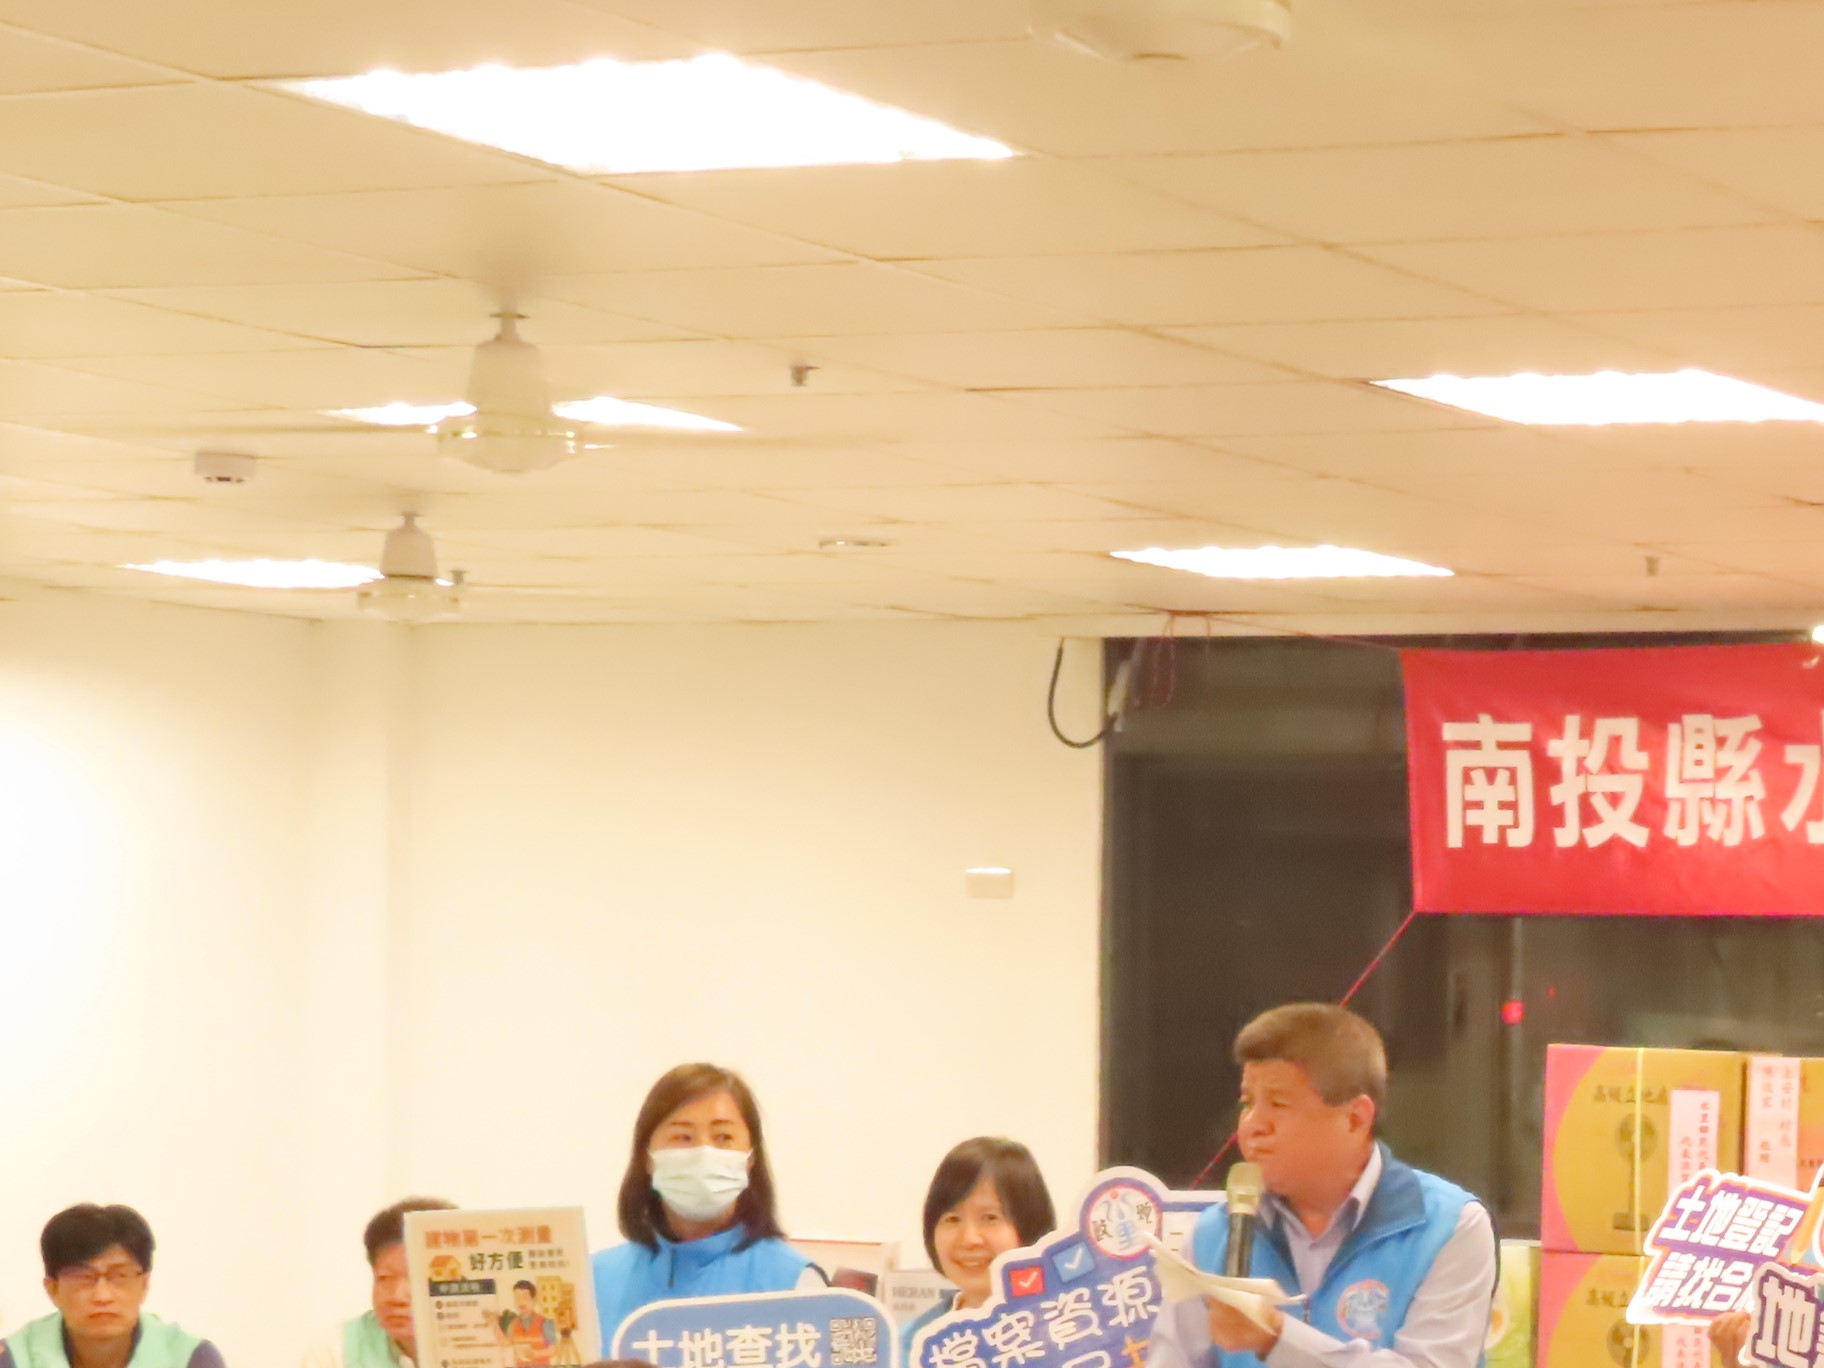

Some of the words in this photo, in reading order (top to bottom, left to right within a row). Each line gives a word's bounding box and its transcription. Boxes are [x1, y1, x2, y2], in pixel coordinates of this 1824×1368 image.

[1659, 1185, 1805, 1256] 土地登記
[1646, 1251, 1758, 1313] 請找合
